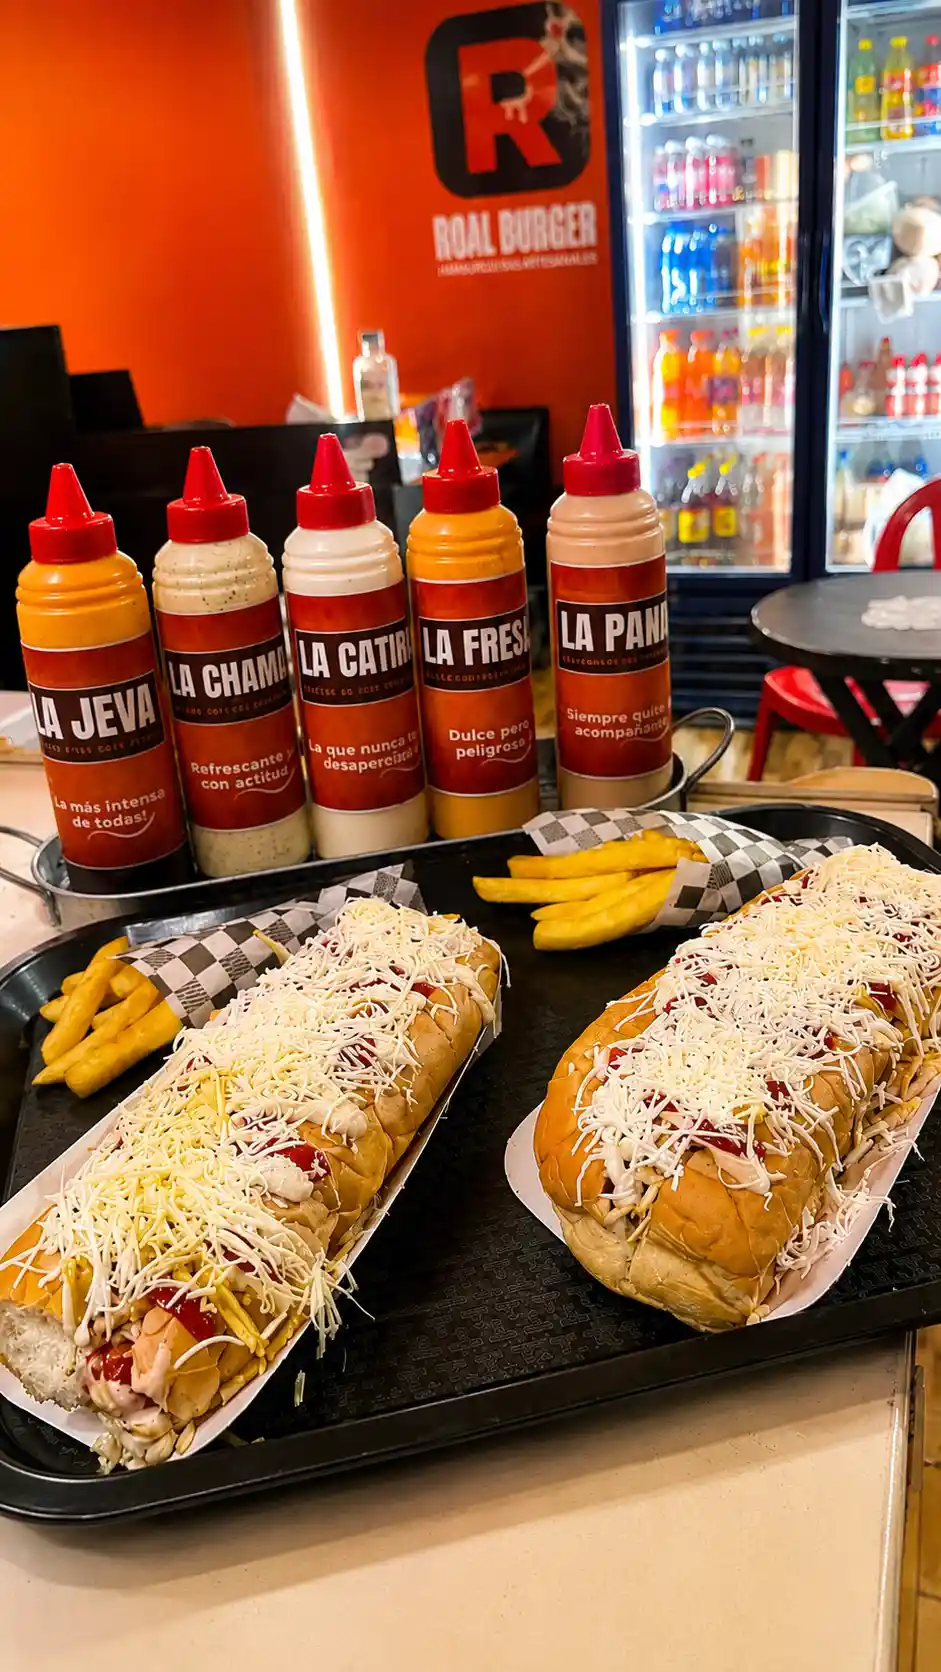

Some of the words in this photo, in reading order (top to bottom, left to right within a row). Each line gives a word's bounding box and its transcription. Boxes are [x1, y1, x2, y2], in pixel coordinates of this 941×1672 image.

[433, 212, 497, 261] ROAL
[498, 201, 597, 255] BURGER
[561, 610, 593, 653] LA
[299, 640, 331, 678] LA
[422, 627, 454, 666] LA
[168, 660, 197, 699] LA
[31, 691, 63, 741] LA
[71, 683, 156, 741] JEVA
[567, 707, 628, 726] Siempre
[449, 728, 496, 742] Dulce
[500, 718, 530, 741] pero
[308, 738, 322, 753] La
[326, 745, 356, 758] que
[360, 736, 405, 755] nunca
[456, 736, 526, 760] peligroso
[190, 752, 284, 775] Refrescante
[201, 779, 230, 790] con
[235, 765, 289, 789] actitud
[54, 795, 67, 810] La
[69, 801, 101, 813] más
[105, 788, 166, 812] intensa
[72, 815, 90, 828] de
[95, 809, 148, 828] todas!
